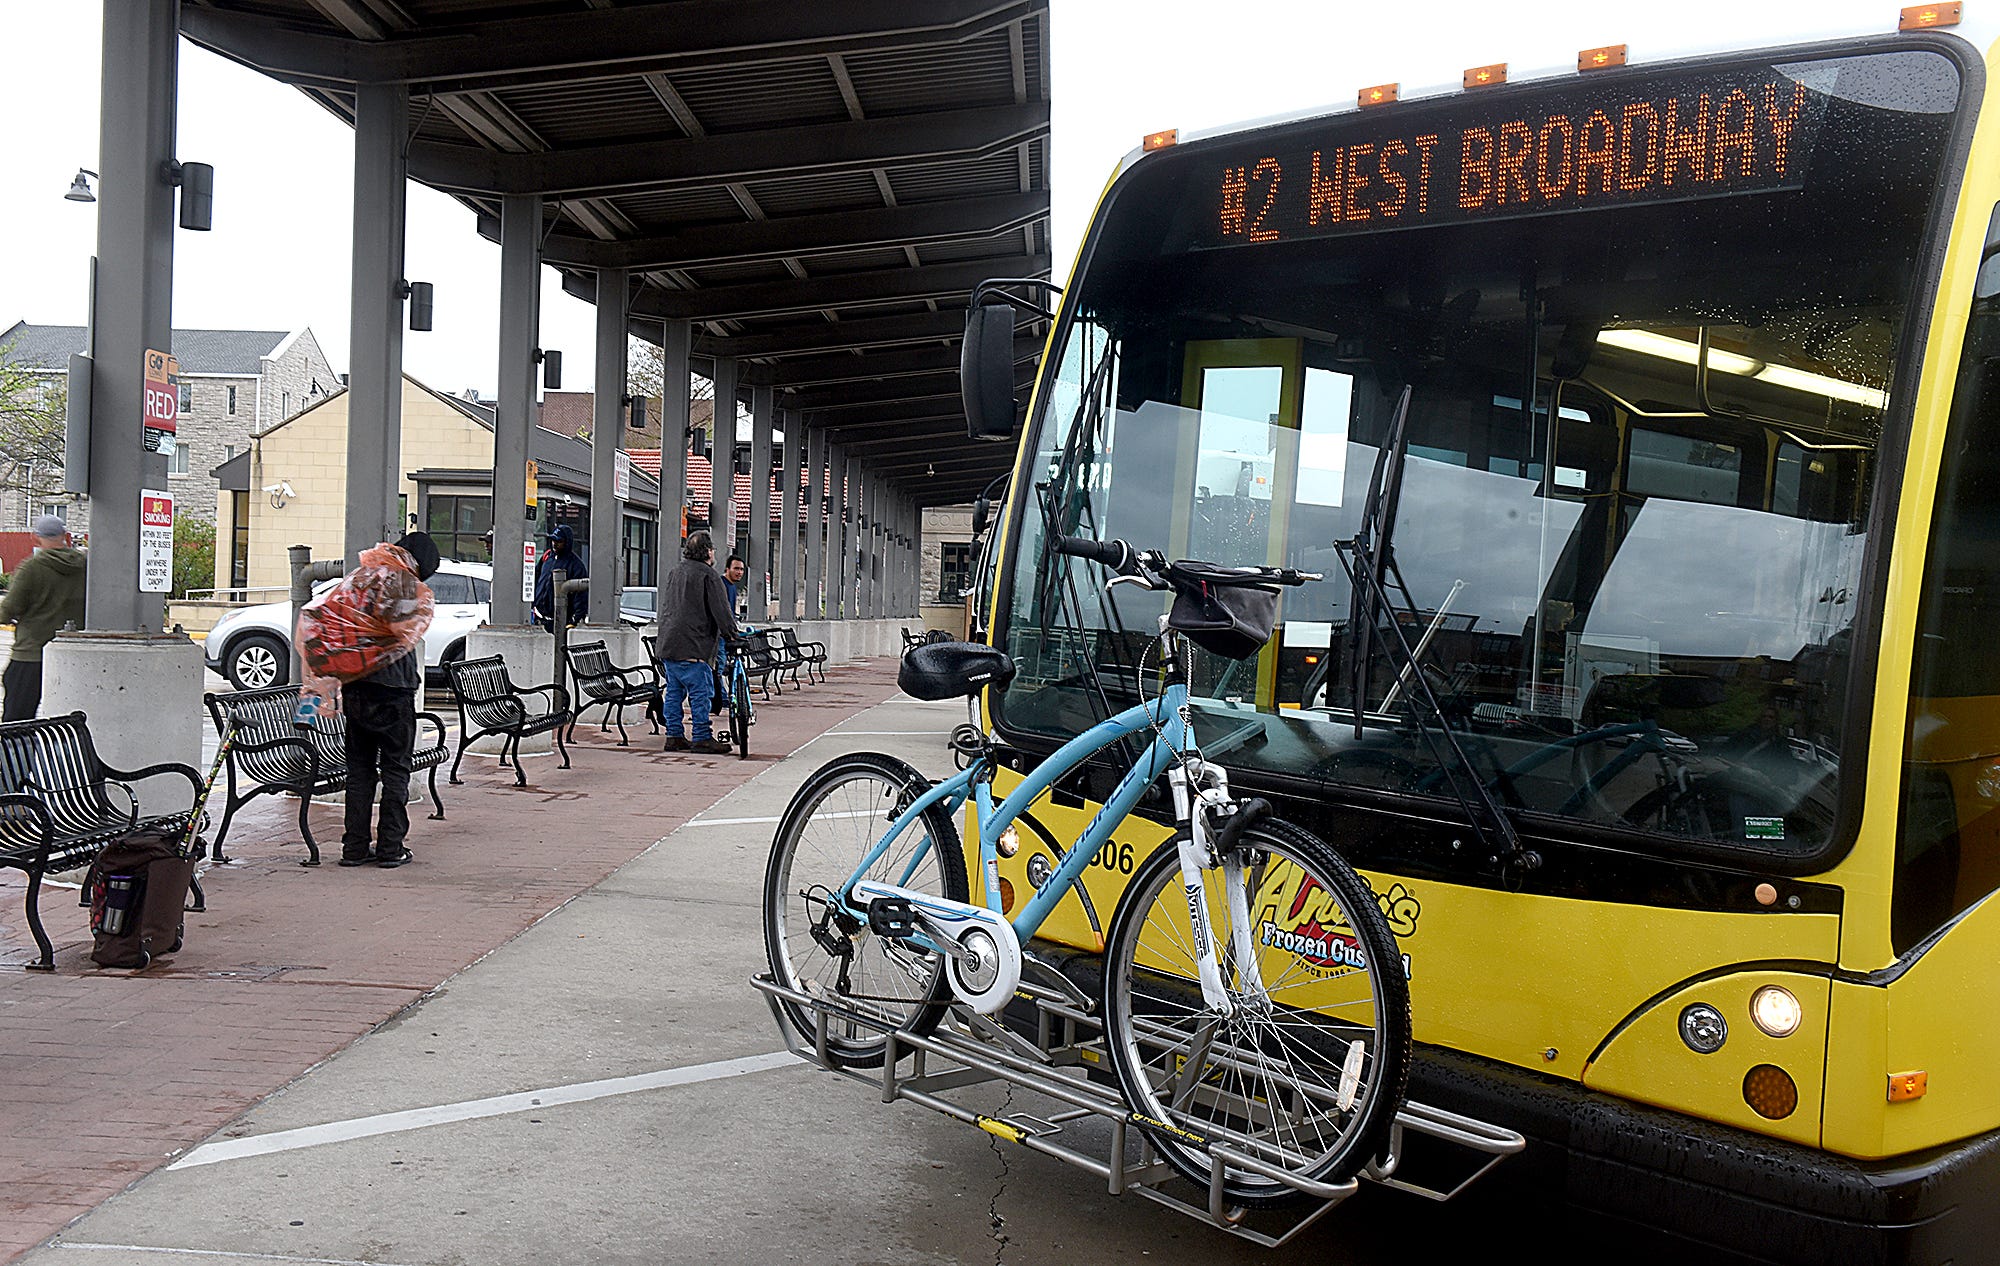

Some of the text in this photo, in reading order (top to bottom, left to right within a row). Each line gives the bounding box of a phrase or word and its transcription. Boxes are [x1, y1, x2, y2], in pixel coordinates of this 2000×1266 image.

[1220, 78, 1805, 243] #2 WEST BROADWAY
[146, 389, 175, 420] RED
[144, 512, 171, 524] SMOKING
[142, 539, 148, 548] OF
[149, 540, 157, 548] THE
[146, 559, 167, 568] ANYWHERE
[145, 568, 167, 577] UNDER THE
[148, 578, 163, 586] CANOPY
[1188, 893, 1205, 961] VITESSE
[1261, 920, 1329, 960] Frozen
